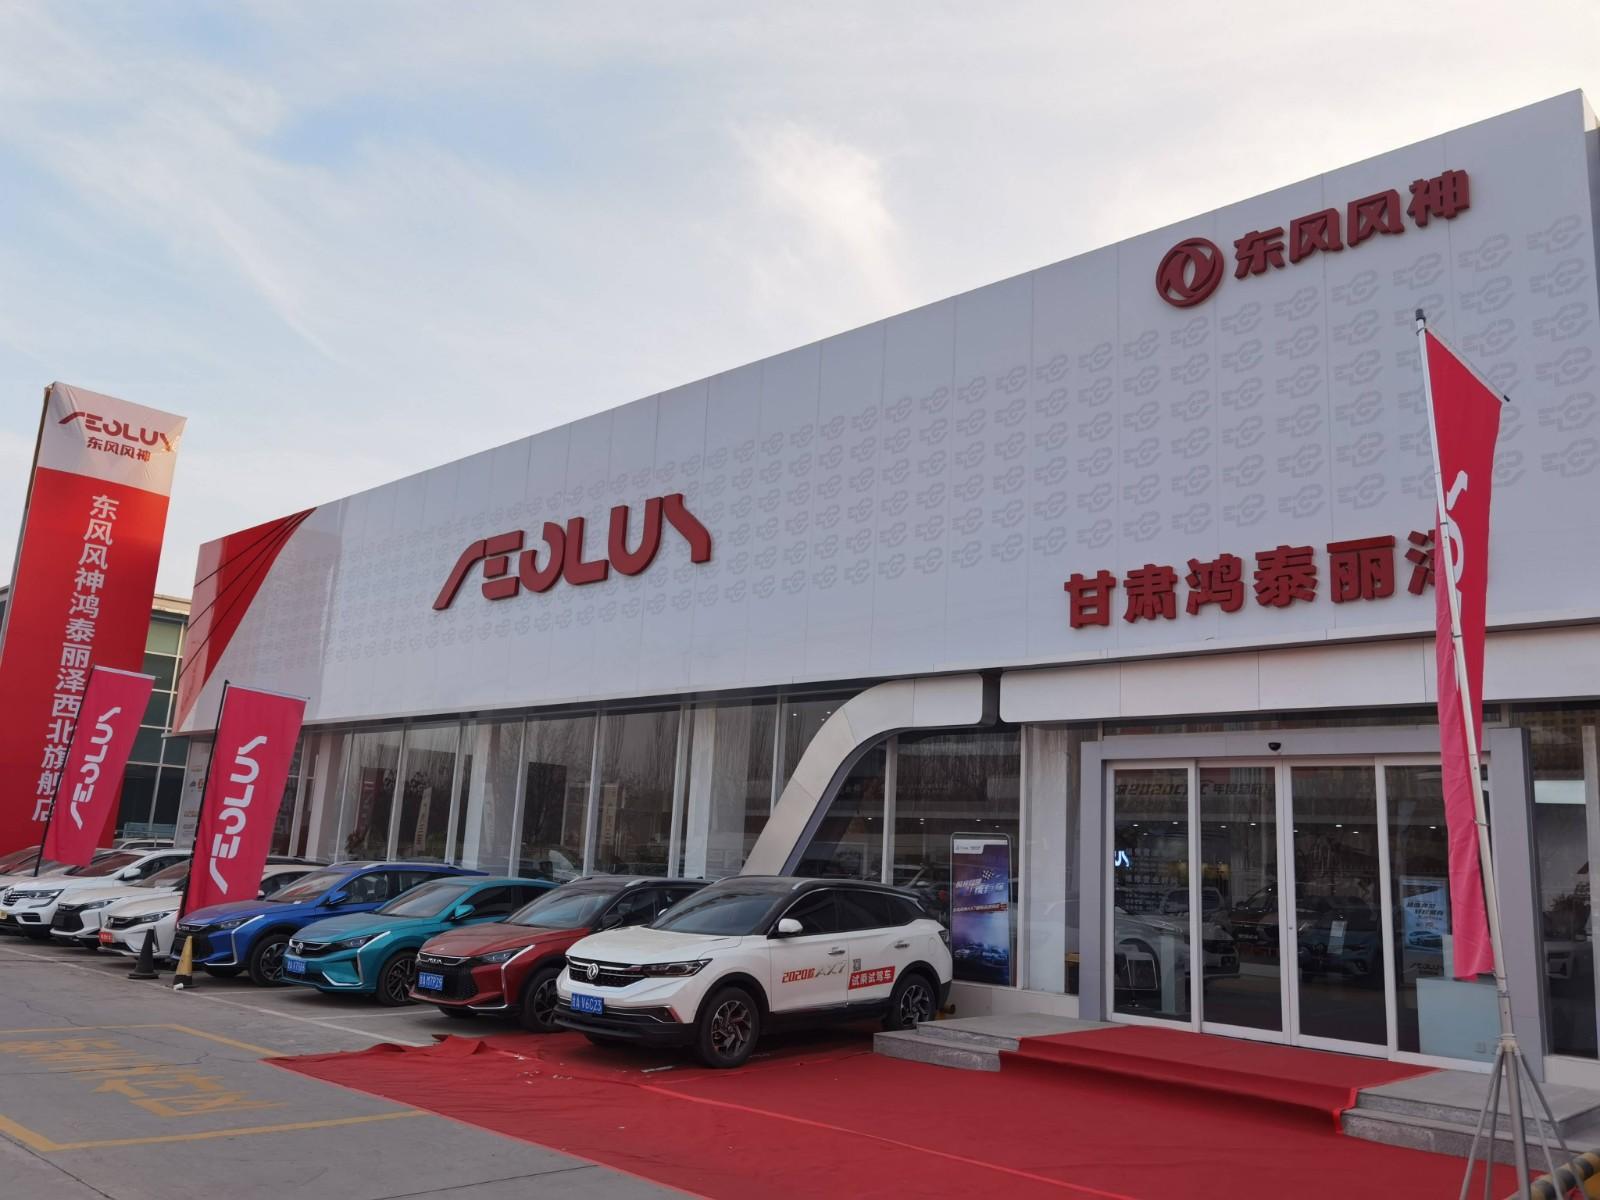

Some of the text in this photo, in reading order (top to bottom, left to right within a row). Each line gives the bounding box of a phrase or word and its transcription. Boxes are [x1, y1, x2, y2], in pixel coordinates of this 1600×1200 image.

[1233, 168, 1471, 279] 东风风神
[86, 436, 151, 463] 东风风神
[432, 492, 711, 611] AEOLUS
